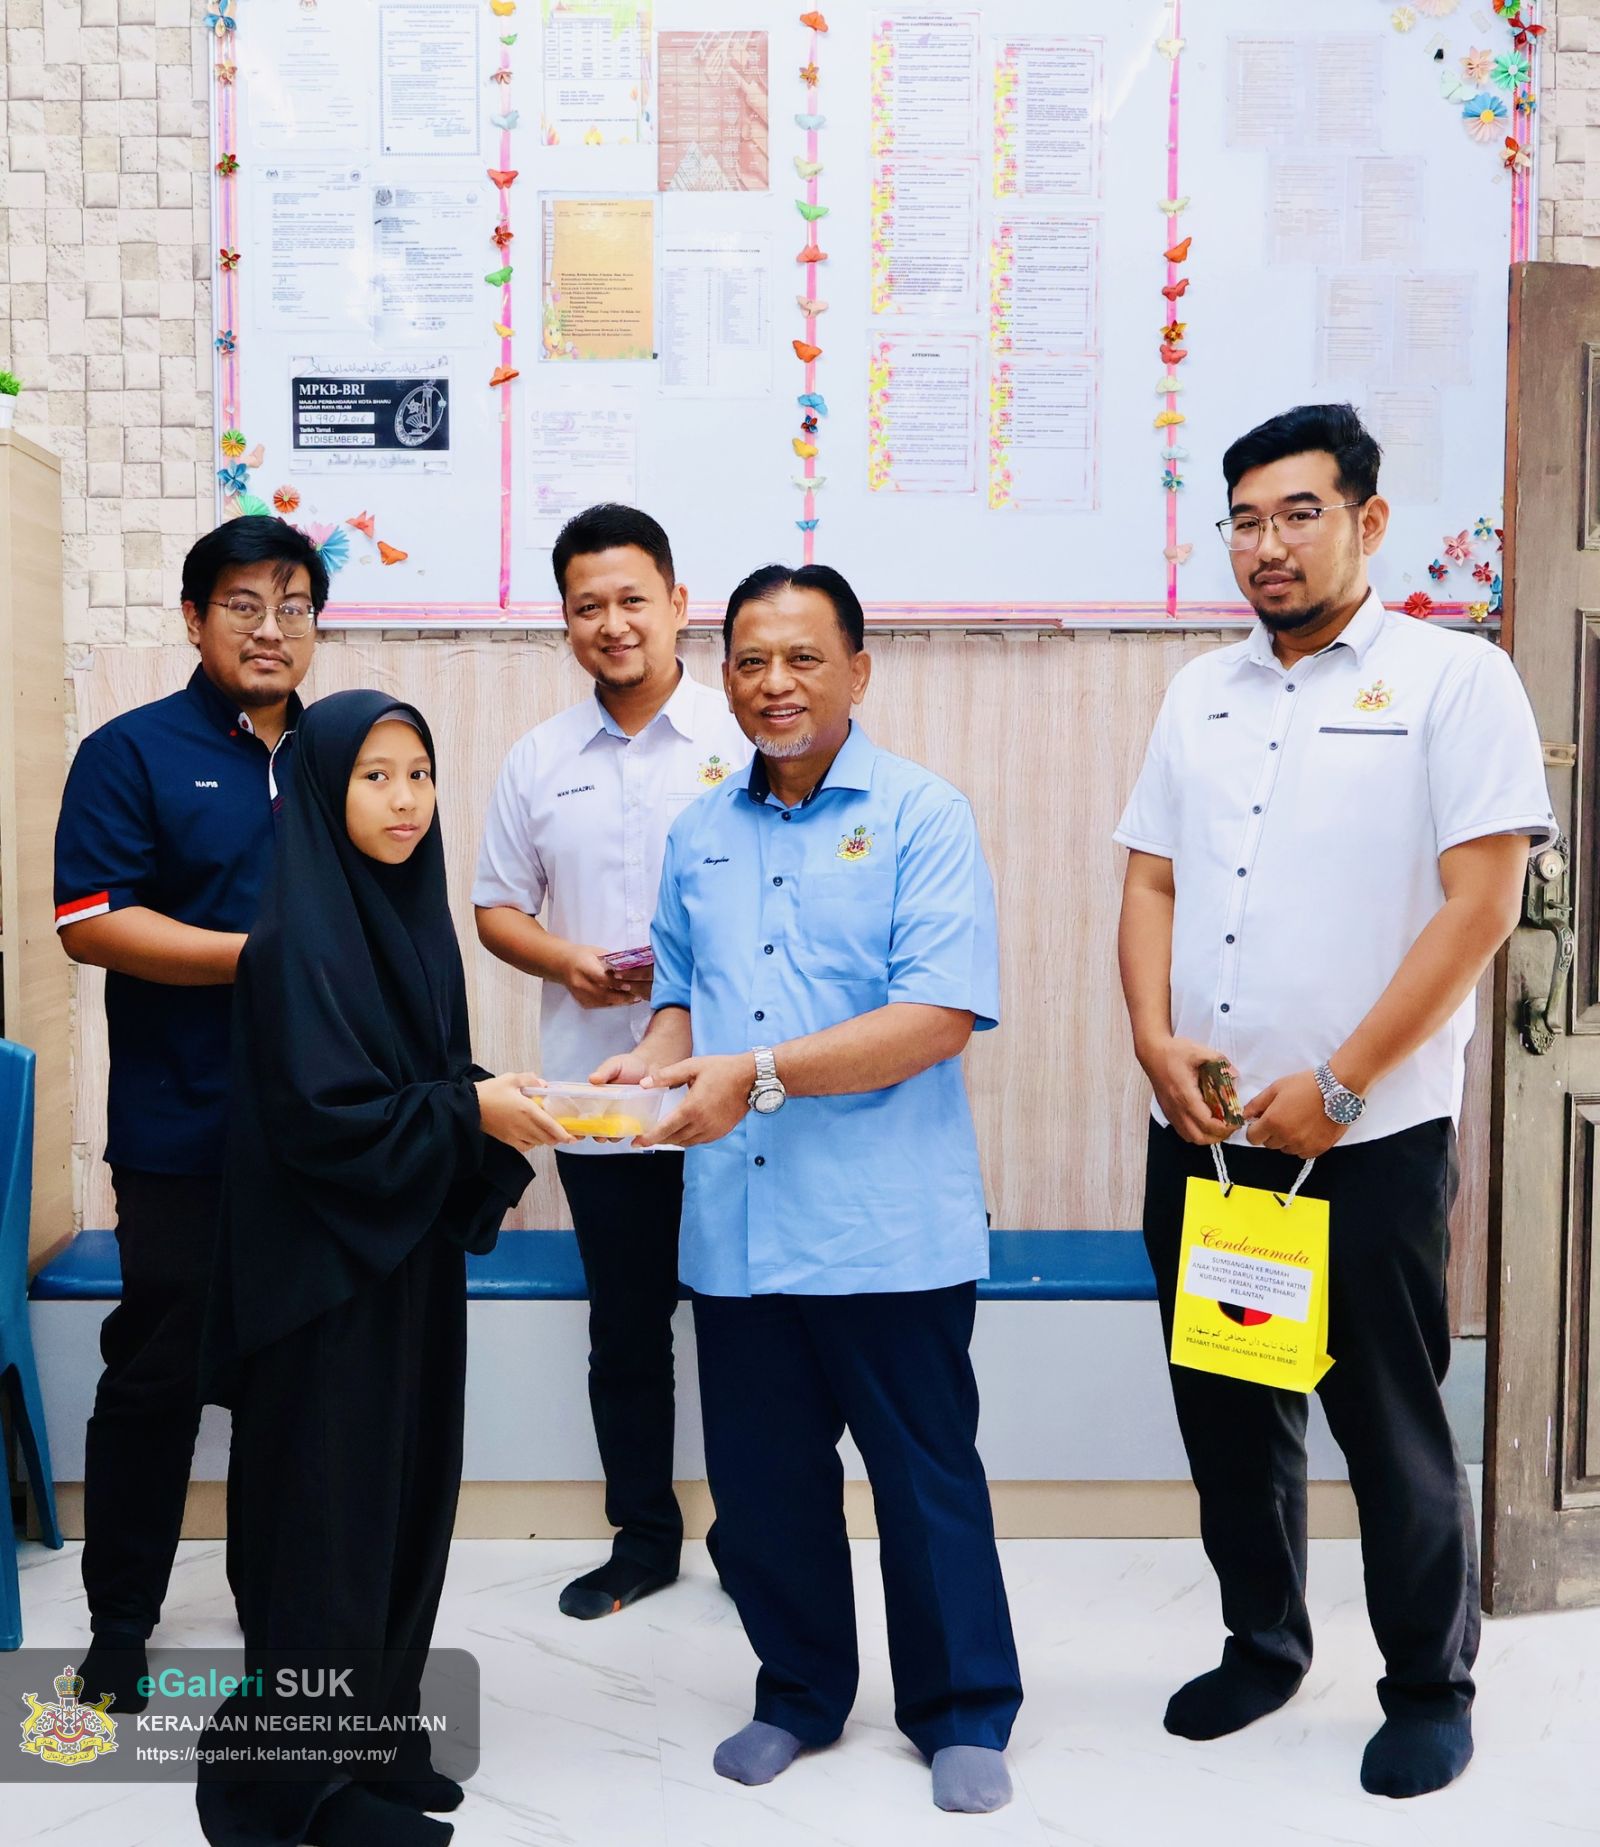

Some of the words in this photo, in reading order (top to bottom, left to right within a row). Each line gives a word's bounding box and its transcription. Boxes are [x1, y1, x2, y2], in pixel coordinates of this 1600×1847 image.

[299, 384, 365, 396] MPKB-BRI
[1200, 1225, 1310, 1265] Cenderamata
[1255, 1265, 1264, 1273] KE
[1232, 1270, 1255, 1281] DARUL
[1230, 1288, 1265, 1301] KELANTAN
